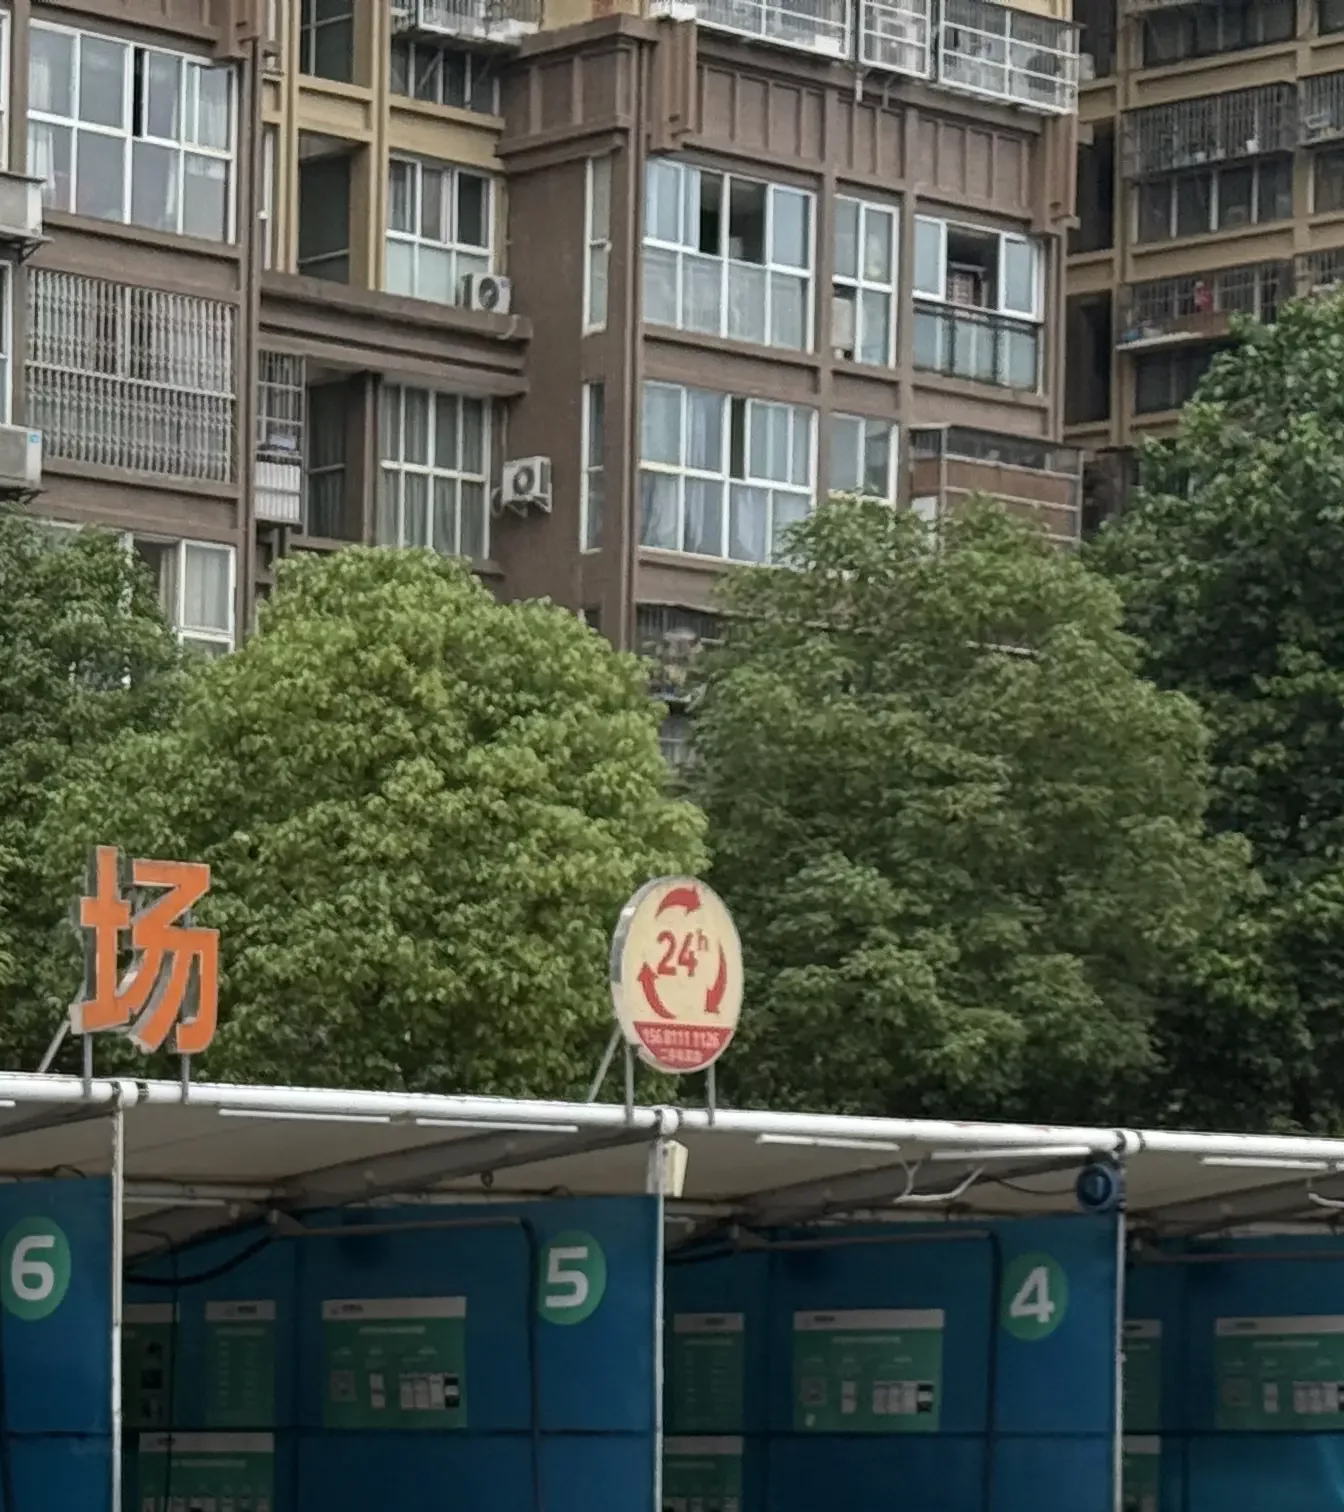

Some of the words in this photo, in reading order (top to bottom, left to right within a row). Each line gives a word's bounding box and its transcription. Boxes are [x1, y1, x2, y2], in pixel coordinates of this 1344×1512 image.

[69, 845, 220, 1054] 场
[656, 928, 710, 978] 24h
[11, 1234, 56, 1302] 6
[545, 1245, 590, 1310] 5
[1009, 1265, 1055, 1324] 4
